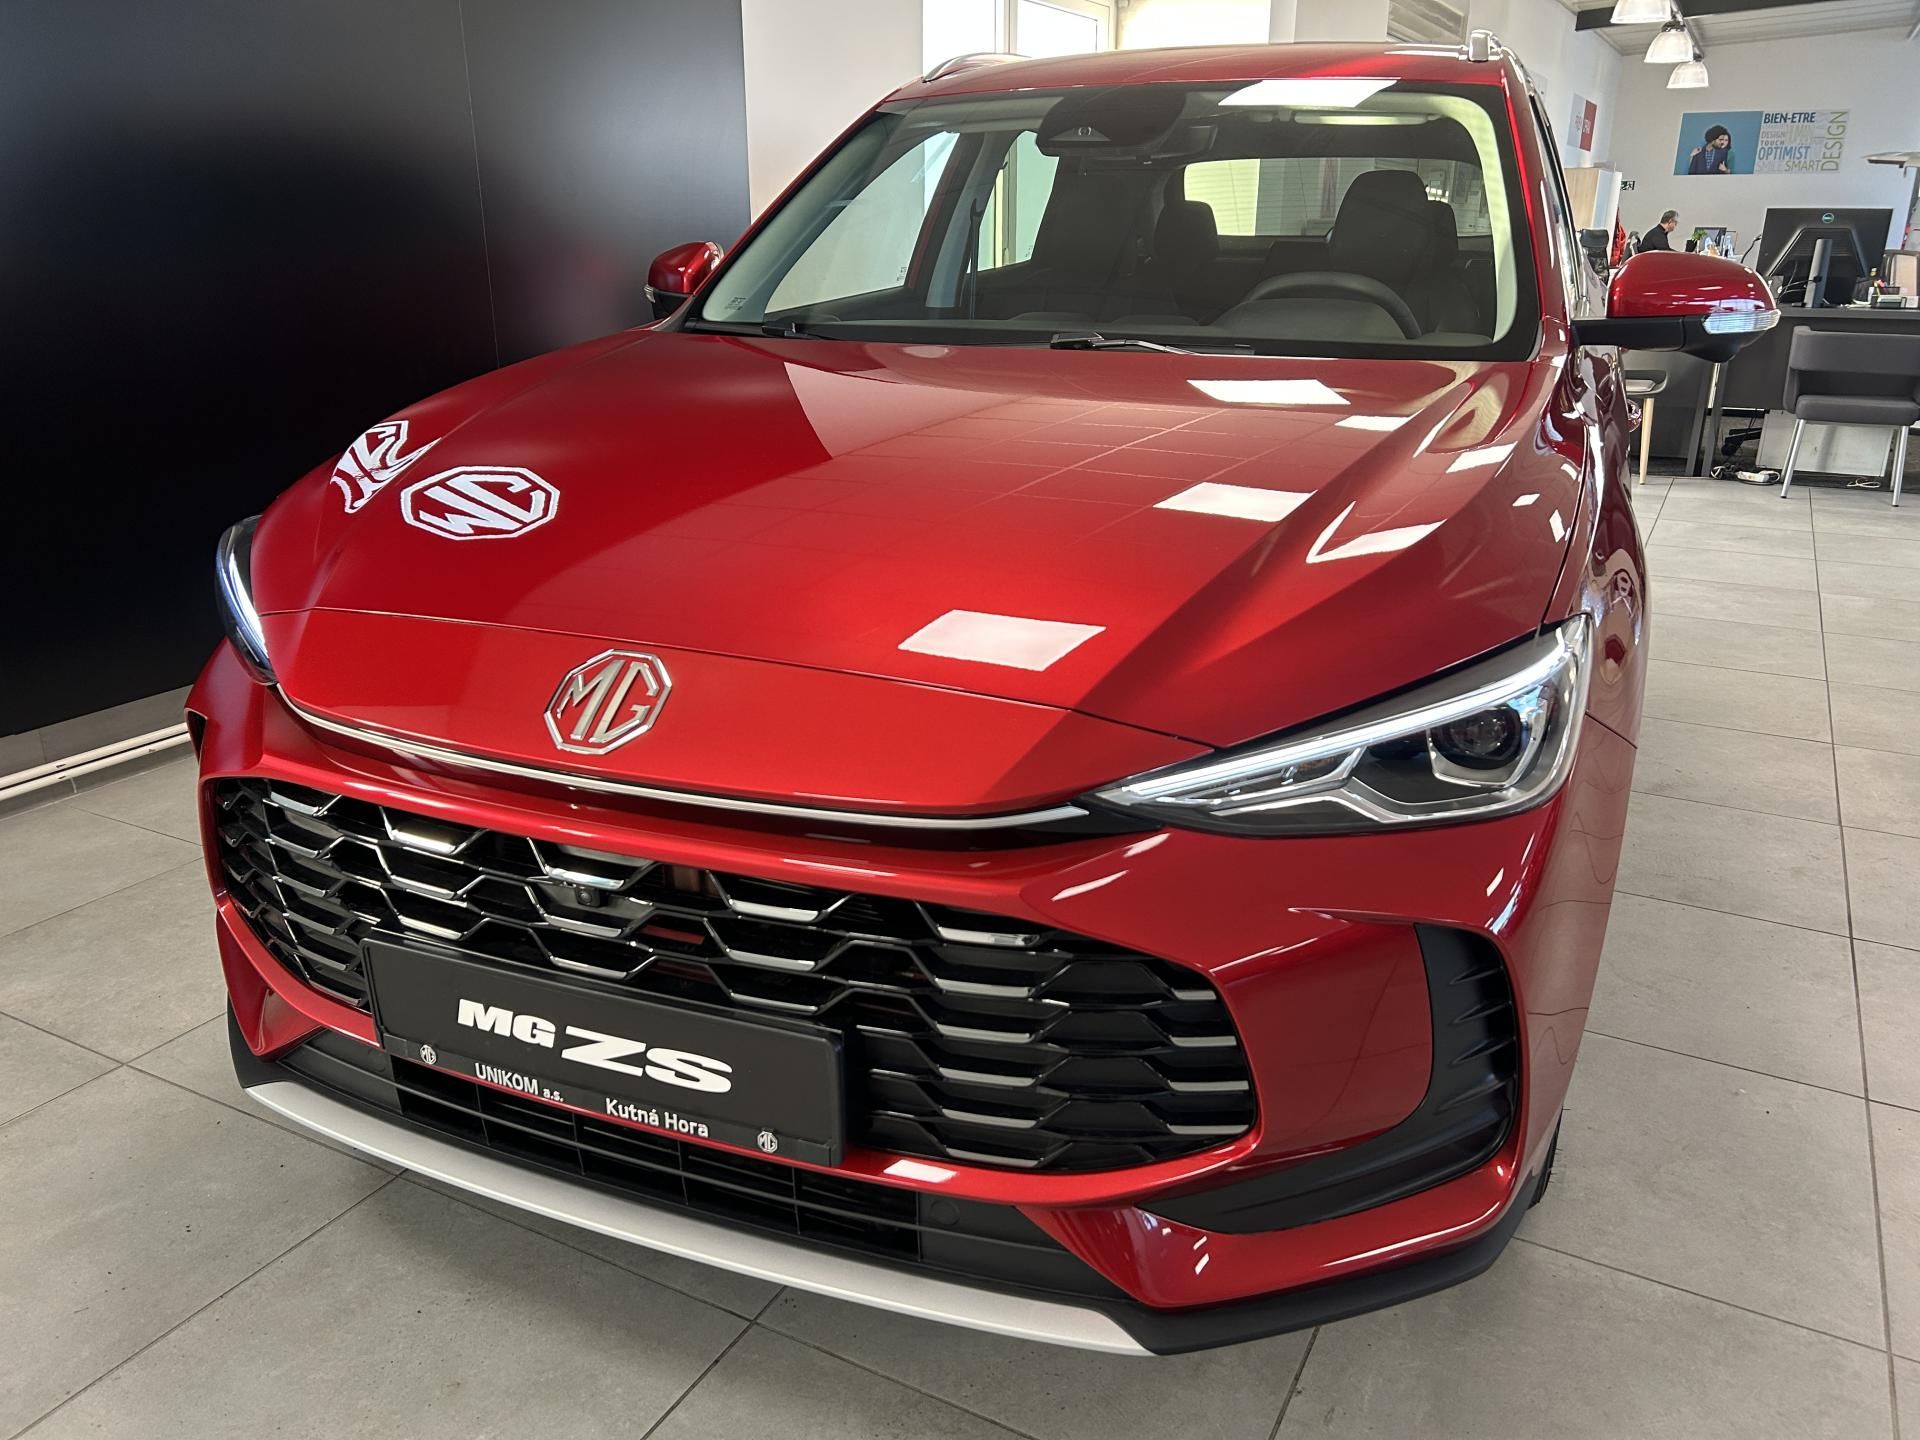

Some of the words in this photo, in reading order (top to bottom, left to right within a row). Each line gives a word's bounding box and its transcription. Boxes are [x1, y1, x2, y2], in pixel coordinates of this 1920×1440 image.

[1763, 112, 1816, 124] BIEN-ETRE
[1758, 146, 1811, 160] OPTIMIST
[1820, 111, 1849, 172] DESIGN
[1784, 160, 1822, 172] SMART
[553, 657, 660, 745] MG
[420, 1045, 437, 1065] MG
[457, 999, 556, 1048] MG
[561, 1025, 733, 1093] ZS
[475, 1062, 539, 1096] UNIKOM
[543, 1088, 564, 1102] a.s.
[605, 1098, 659, 1127] Kutná
[664, 1111, 709, 1138] Hora
[757, 1131, 778, 1154] MG
